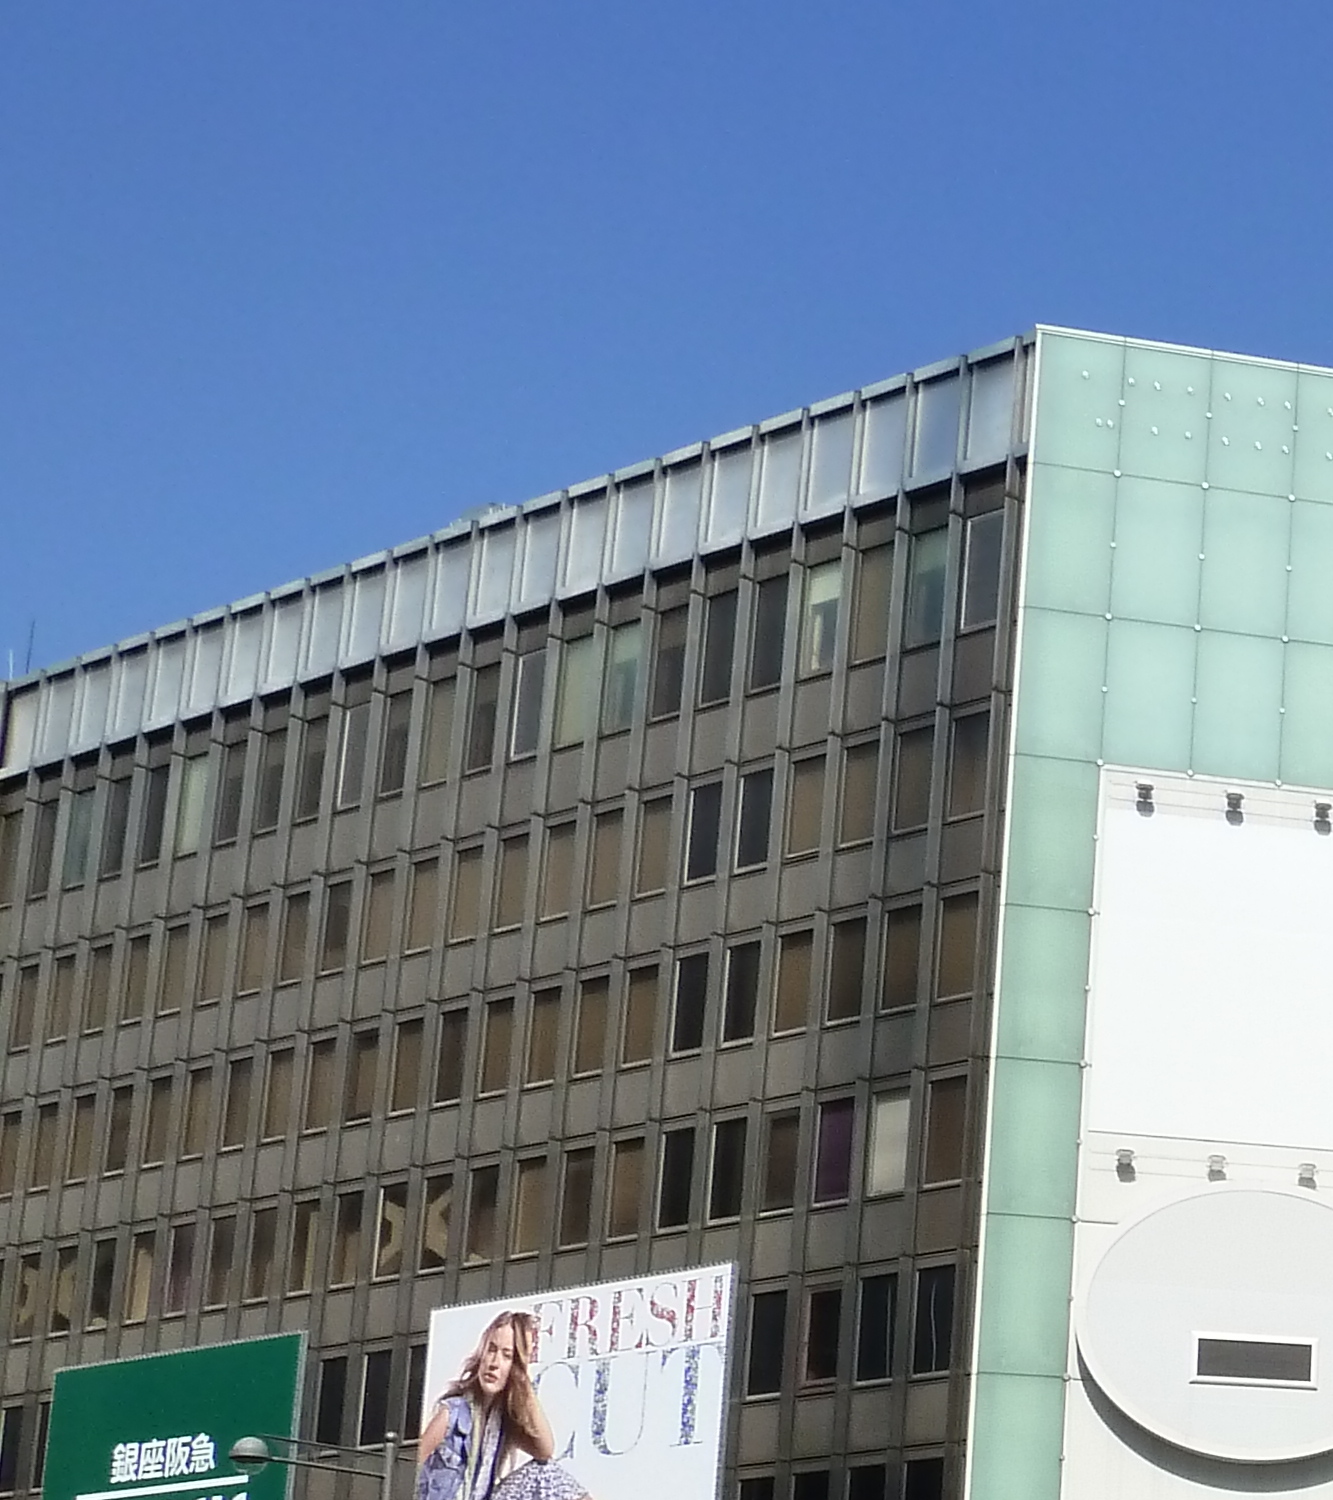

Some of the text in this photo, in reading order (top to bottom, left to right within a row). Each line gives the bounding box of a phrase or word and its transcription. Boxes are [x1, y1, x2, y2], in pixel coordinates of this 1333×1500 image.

[529, 1274, 725, 1363] FRESH
[531, 1344, 727, 1460] CUT
[110, 1432, 216, 1484] 銀座阪急
